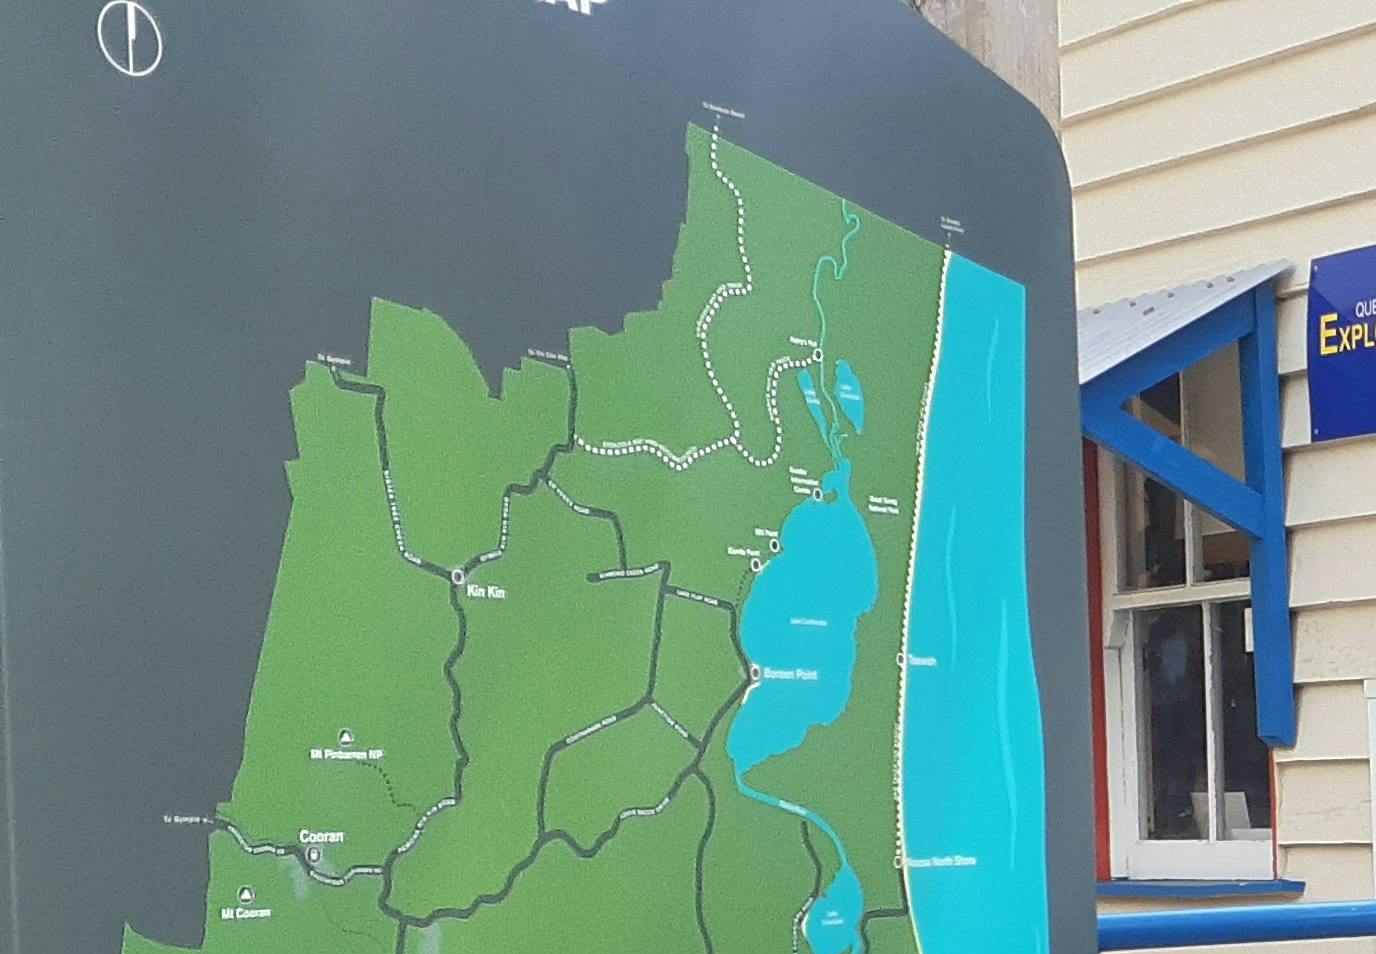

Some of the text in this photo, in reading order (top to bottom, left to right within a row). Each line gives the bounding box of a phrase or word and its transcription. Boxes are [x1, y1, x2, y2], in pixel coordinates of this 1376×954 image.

[467, 584, 505, 600] Kin Kin
[299, 829, 344, 843] Cooran
